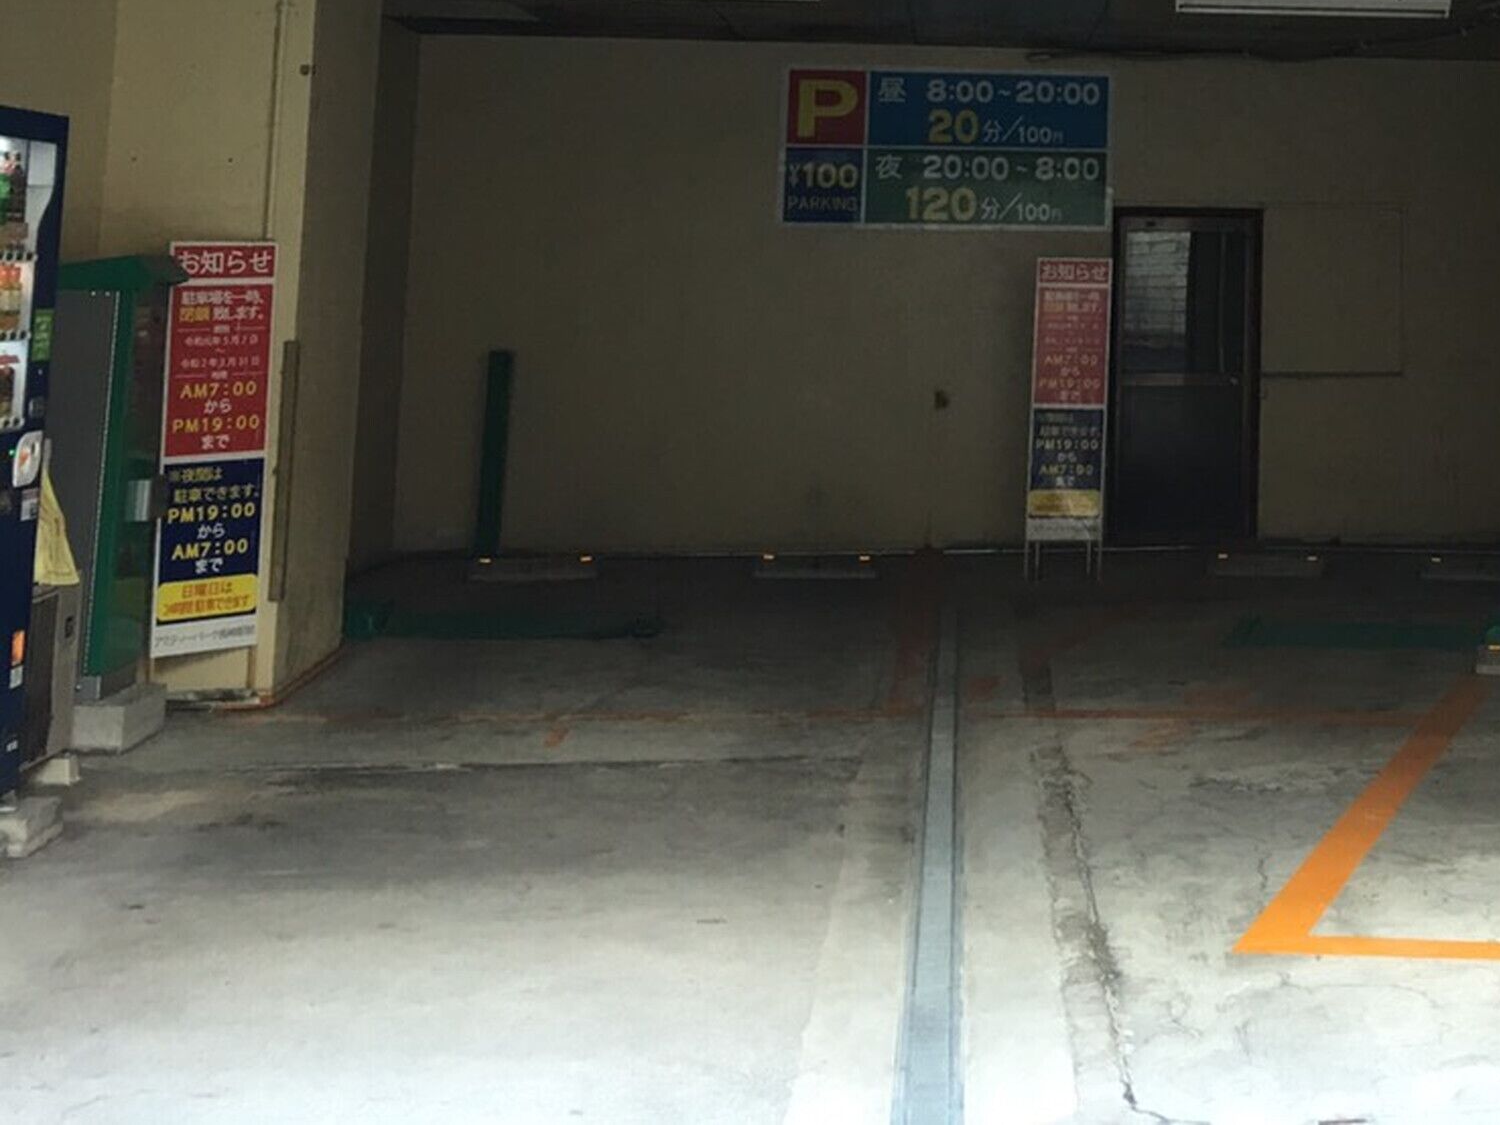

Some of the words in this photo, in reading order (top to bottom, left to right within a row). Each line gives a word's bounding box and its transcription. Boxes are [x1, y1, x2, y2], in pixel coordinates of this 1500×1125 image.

[878, 77, 906, 103] 昼
[796, 78, 859, 138] P
[875, 154, 903, 180] 夜
[787, 195, 858, 212] PARKING
[178, 251, 272, 274] お知らせ
[1042, 264, 1106, 281] お知らせ
[203, 400, 232, 414] から
[171, 415, 260, 434] PM19:00
[201, 435, 230, 450] まで
[166, 502, 255, 524] PM19:00
[196, 524, 226, 540] から
[171, 539, 249, 561] AM7:00
[194, 558, 224, 574] まで
